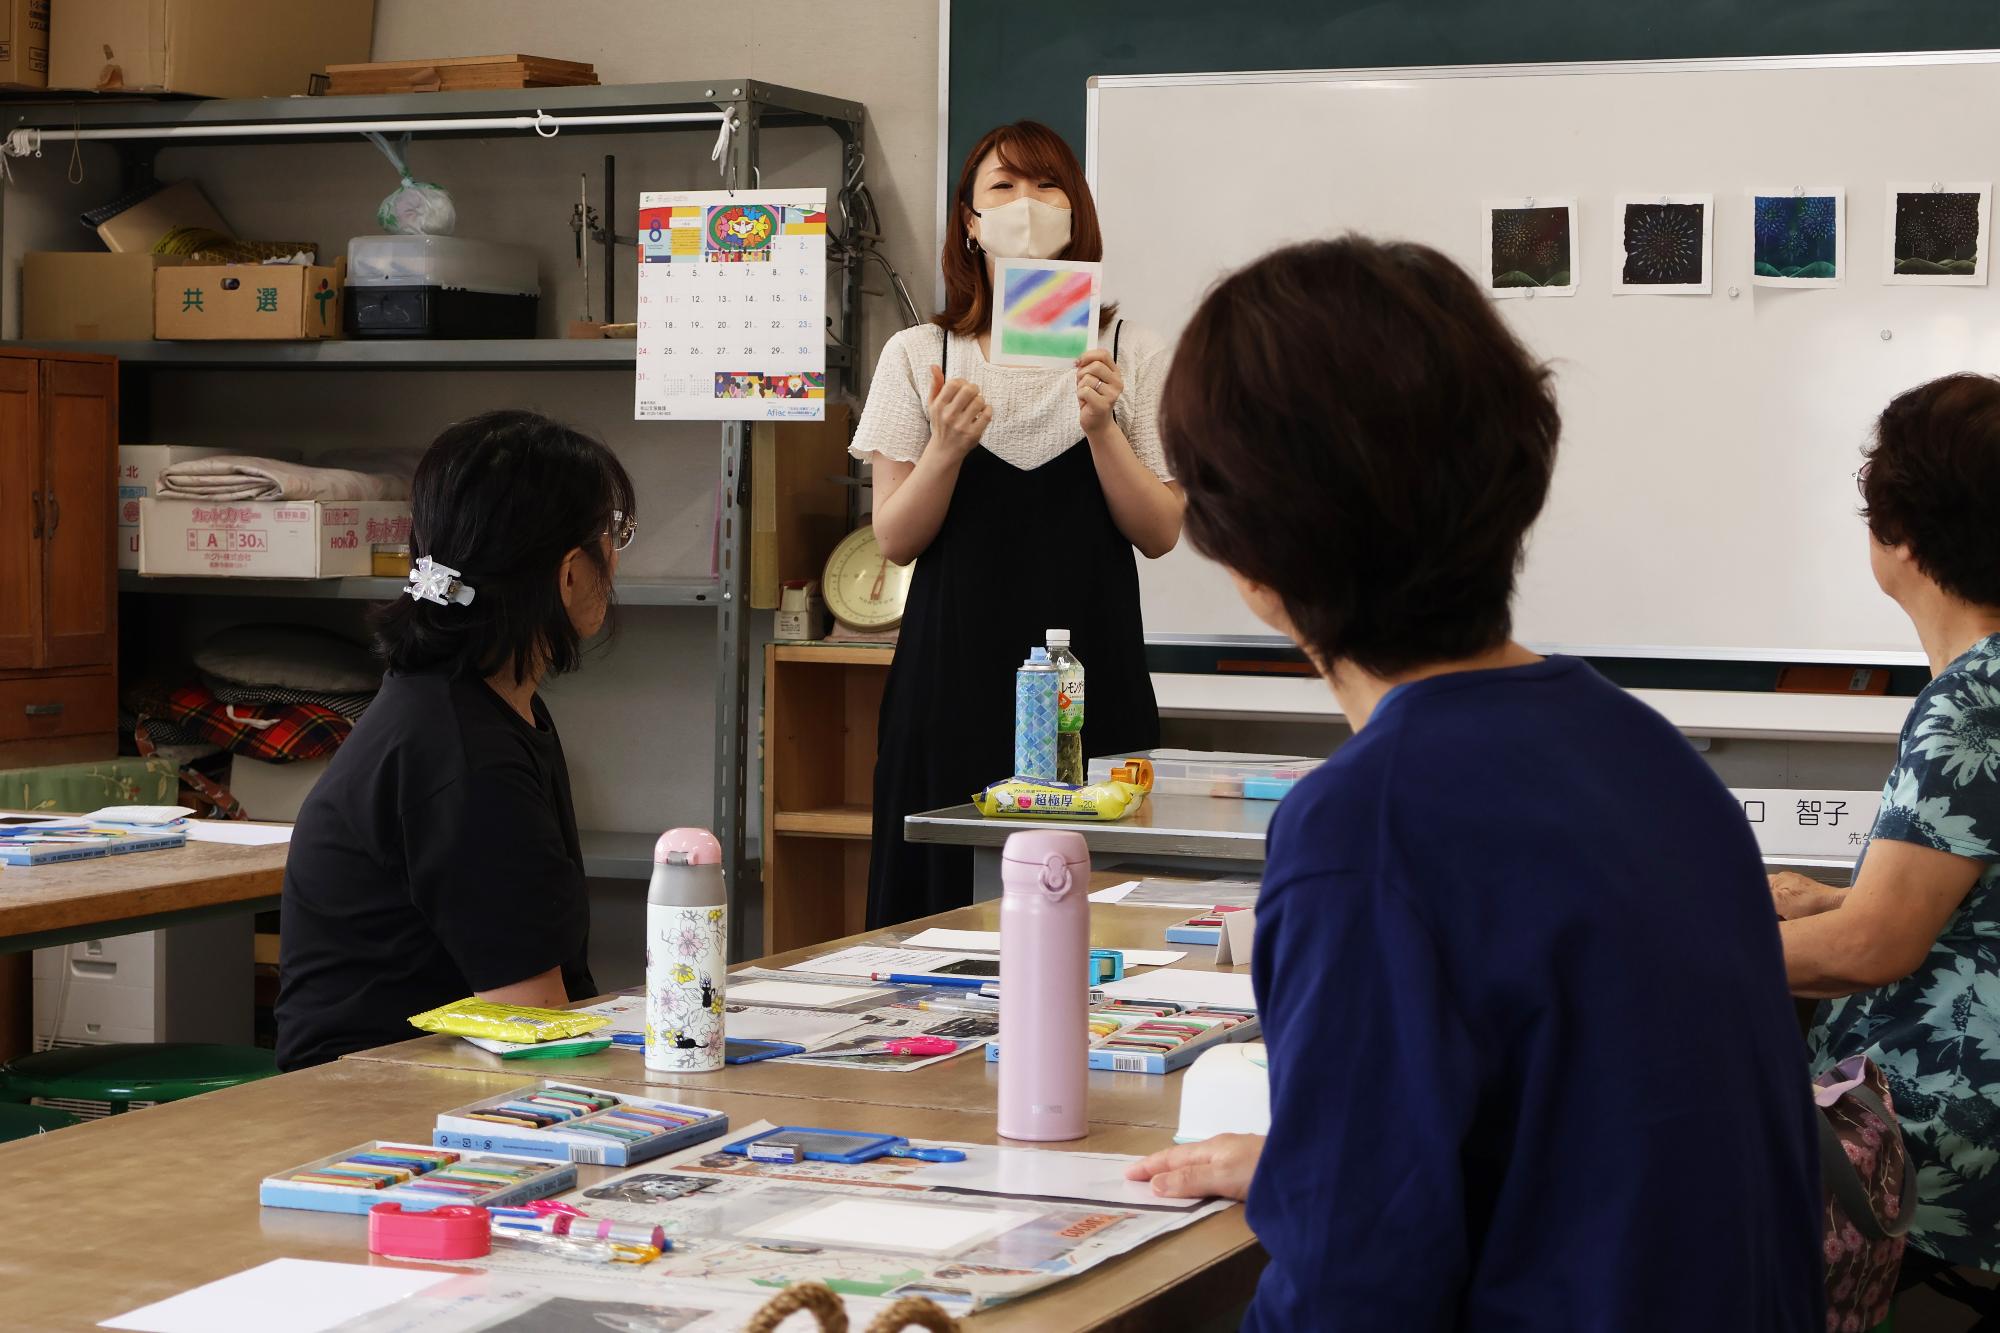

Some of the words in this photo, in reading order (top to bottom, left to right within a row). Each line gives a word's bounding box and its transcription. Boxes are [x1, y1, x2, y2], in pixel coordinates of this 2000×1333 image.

[649, 219, 661, 242] 8
[772, 241, 776, 249] 1
[800, 241, 804, 249] 2
[640, 270, 645, 278] 3
[666, 269, 671, 277] 4
[692, 269, 697, 277] 5
[719, 269, 723, 277] 6
[745, 269, 750, 277] 7
[772, 269, 777, 277] 8
[800, 268, 804, 276] 9
[182, 288, 204, 312] 共
[256, 288, 278, 312] 選
[639, 295, 648, 303] 10
[666, 295, 673, 303] 11
[691, 295, 700, 303] 12
[718, 295, 727, 303] 13
[744, 295, 753, 303] 14
[772, 295, 780, 303] 15
[799, 294, 807, 302] 16
[638, 321, 647, 329] 17
[664, 321, 673, 329] 18
[690, 321, 699, 329] 19
[717, 321, 726, 329] 20
[744, 321, 753, 329] 21
[771, 321, 780, 329] 22
[798, 320, 807, 328] 23
[638, 347, 647, 355] 24
[664, 347, 673, 355] 25
[690, 347, 699, 355] 26
[717, 347, 726, 355] 27
[744, 347, 753, 355] 28
[771, 347, 780, 355] 29
[798, 347, 807, 355] 30
[638, 373, 645, 381] 31
[767, 408, 786, 416] Aflac
[126, 466, 138, 478] 北
[208, 534, 217, 547] A
[1035, 794, 1072, 806] 超極厚
[1797, 799, 1848, 826] 智子
